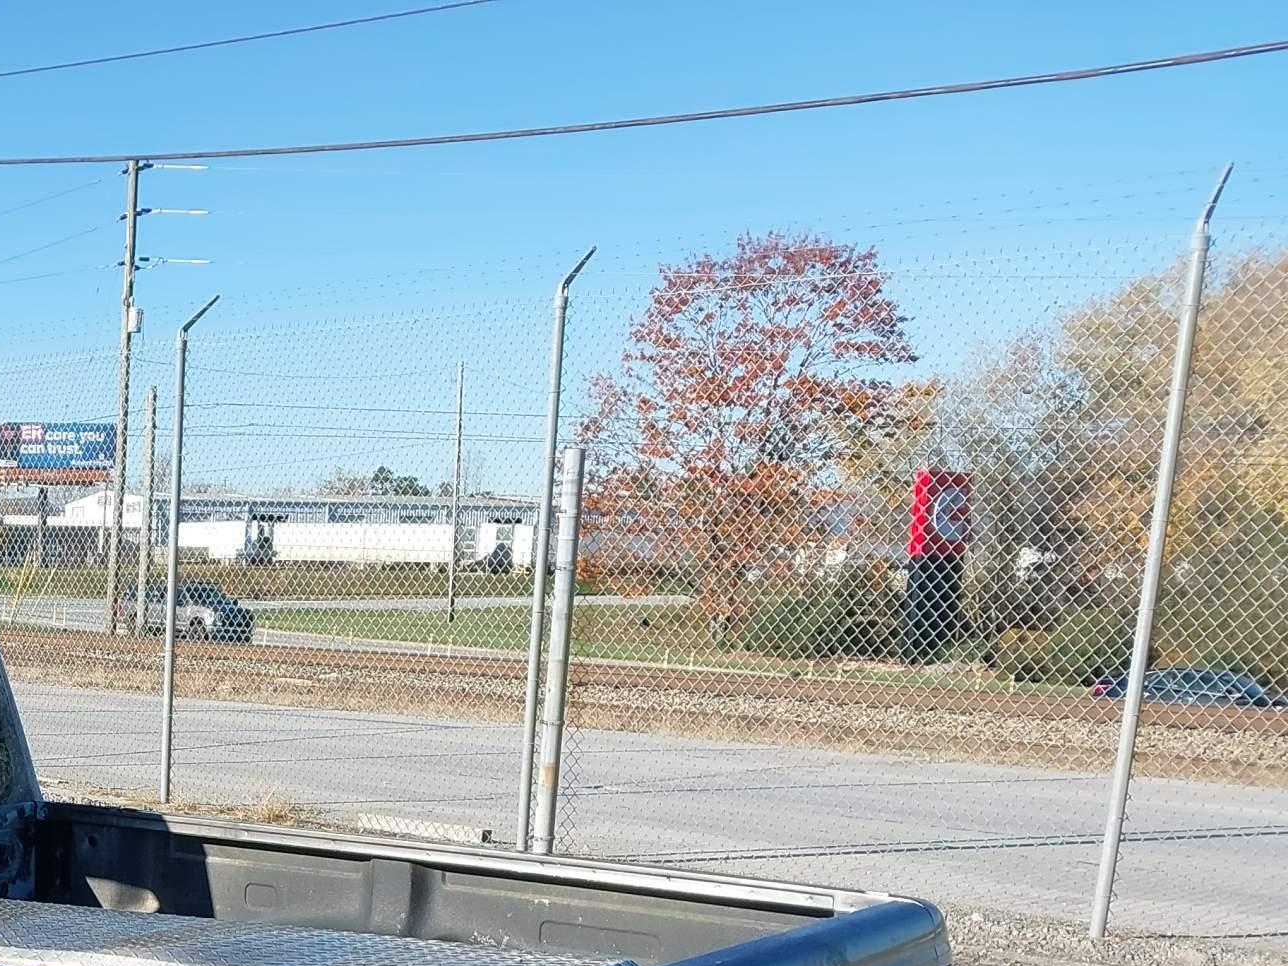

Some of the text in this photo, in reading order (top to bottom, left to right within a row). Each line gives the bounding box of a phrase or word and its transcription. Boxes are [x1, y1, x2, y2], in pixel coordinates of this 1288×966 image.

[22, 425, 106, 444] ER care you
[20, 442, 83, 454] can trust.
